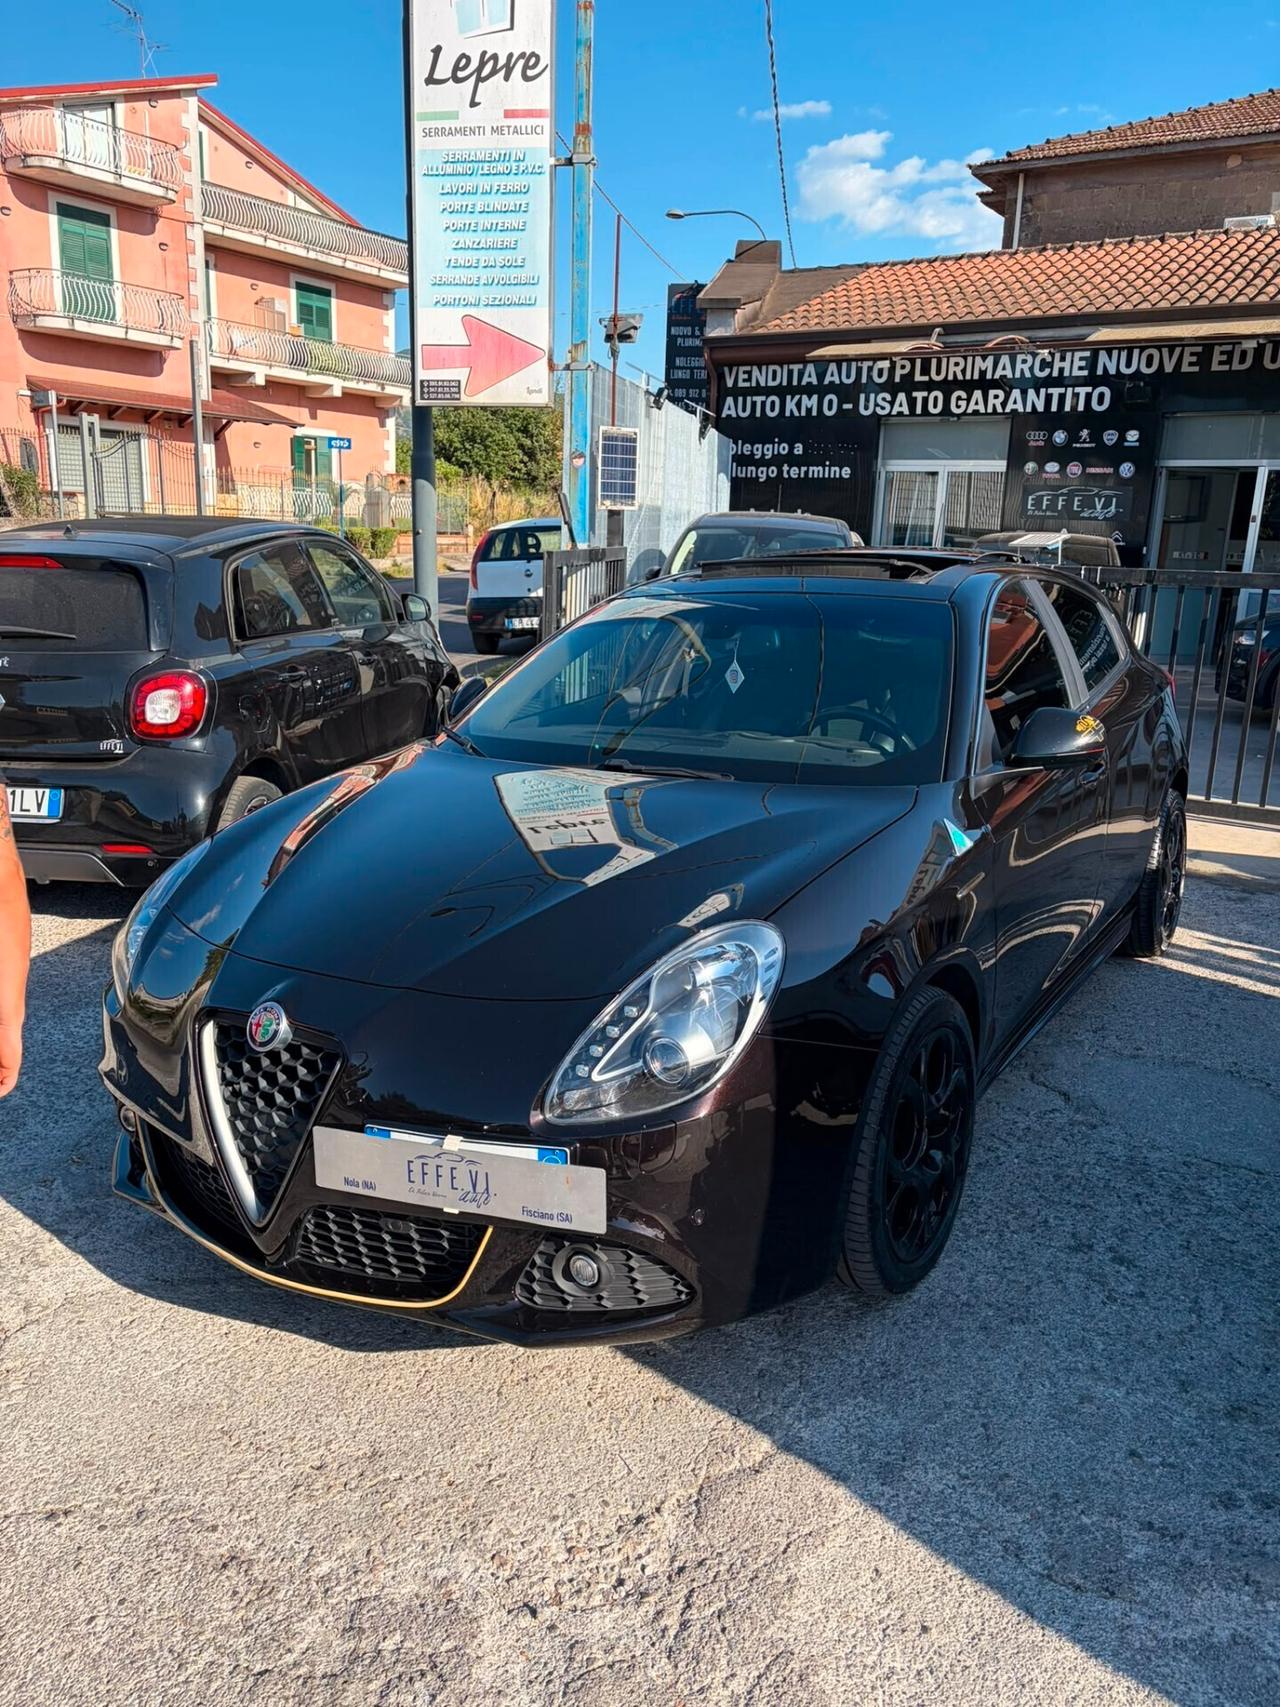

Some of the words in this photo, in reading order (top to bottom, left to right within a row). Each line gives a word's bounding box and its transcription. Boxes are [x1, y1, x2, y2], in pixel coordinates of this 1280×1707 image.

[424, 44, 549, 108] Lepre
[422, 126, 486, 138] SERRAMENTI
[490, 125, 544, 136] METALLICI
[442, 150, 511, 163] SERRAMENTI
[513, 150, 525, 162] IN
[440, 182, 478, 195] LAVORI
[480, 182, 491, 194] IN
[494, 182, 530, 194] FERRO
[440, 201, 474, 213] PORTE
[478, 201, 529, 212] BLINDATE
[443, 220, 478, 232] PORTE
[480, 219, 526, 231] INTERNE
[451, 238, 518, 250] ZANZARIERE
[445, 257, 479, 268] TENDE
[481, 257, 496, 267] DA
[498, 256, 525, 267] SOLE
[430, 274, 481, 286] SERRANDE
[482, 274, 539, 286] AVVOLGIBILI
[433, 295, 481, 306] PORTONI
[482, 295, 537, 306] SEZIONALI
[671, 326, 692, 336] NUOVO
[723, 363, 818, 388] VENDITA
[823, 359, 889, 385] AUTO
[894, 352, 1091, 383] PLURIMARCHE
[1097, 346, 1202, 376] NUOVE
[1210, 344, 1254, 371] ED
[671, 369, 691, 379] LUNGO
[721, 396, 780, 418] AUTO
[785, 394, 818, 417] KM
[859, 390, 944, 416] USATO
[950, 386, 1111, 414] GARANTITO
[730, 437, 789, 459] oleggio
[793, 443, 803, 455] a
[732, 462, 778, 482] lungo
[782, 461, 851, 479] termine
[343, 1176, 360, 1188] Nola
[361, 1179, 376, 1191] (NA)
[521, 1206, 554, 1221] Fisciano
[556, 1212, 573, 1224] (SA)
